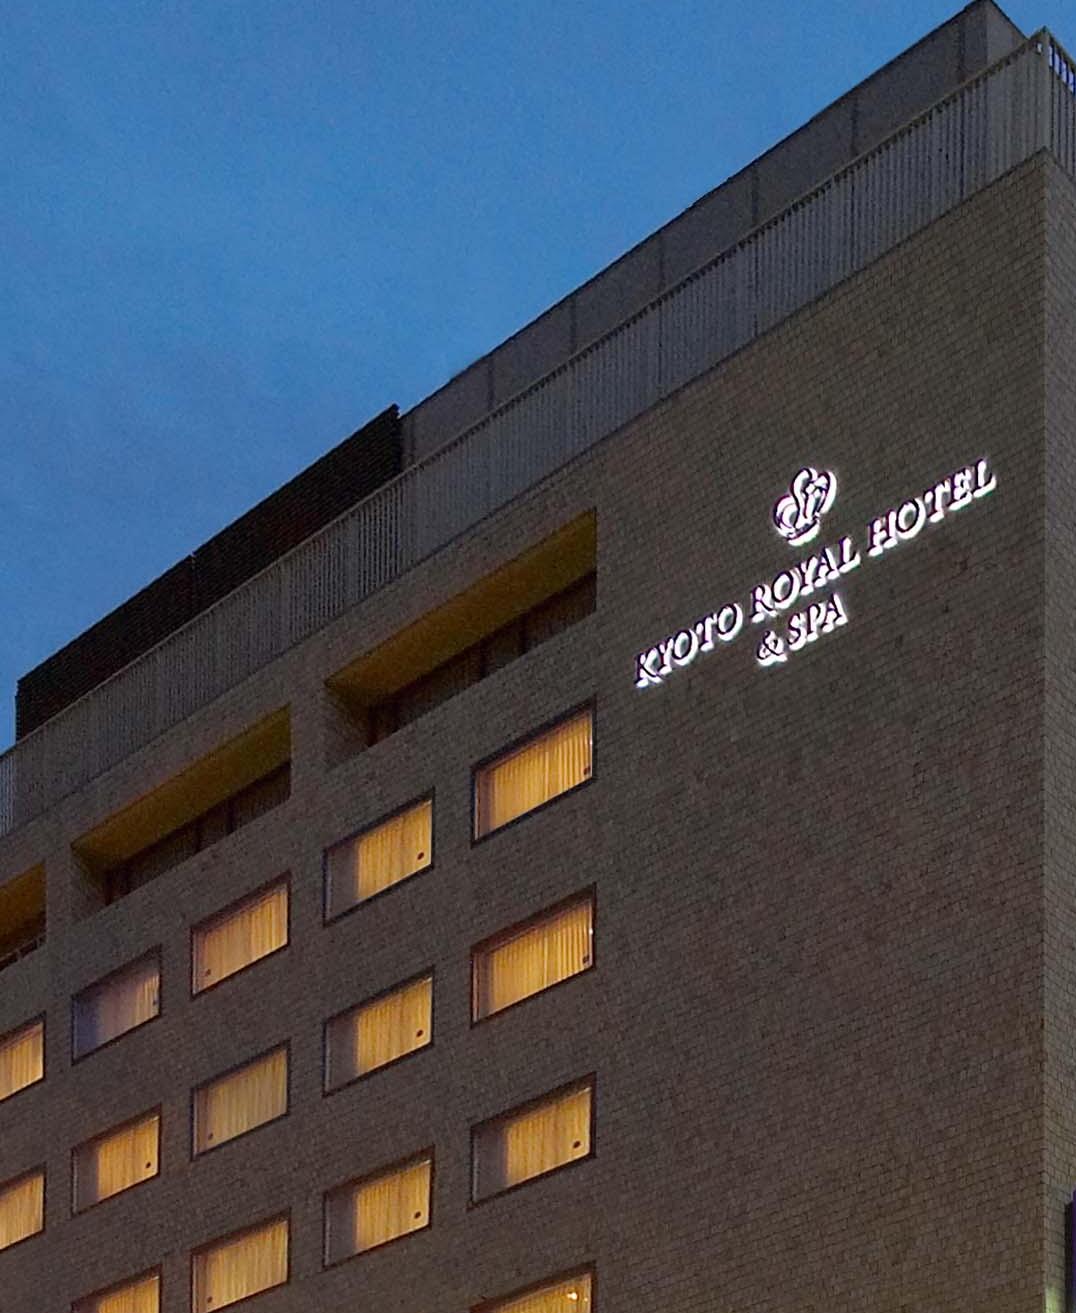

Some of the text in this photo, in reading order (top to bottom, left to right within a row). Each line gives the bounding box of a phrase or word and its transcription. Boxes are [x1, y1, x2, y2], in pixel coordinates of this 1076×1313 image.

[635, 458, 997, 687] KYOTO ROYAL HOTEL
[756, 594, 849, 667] & SPA
